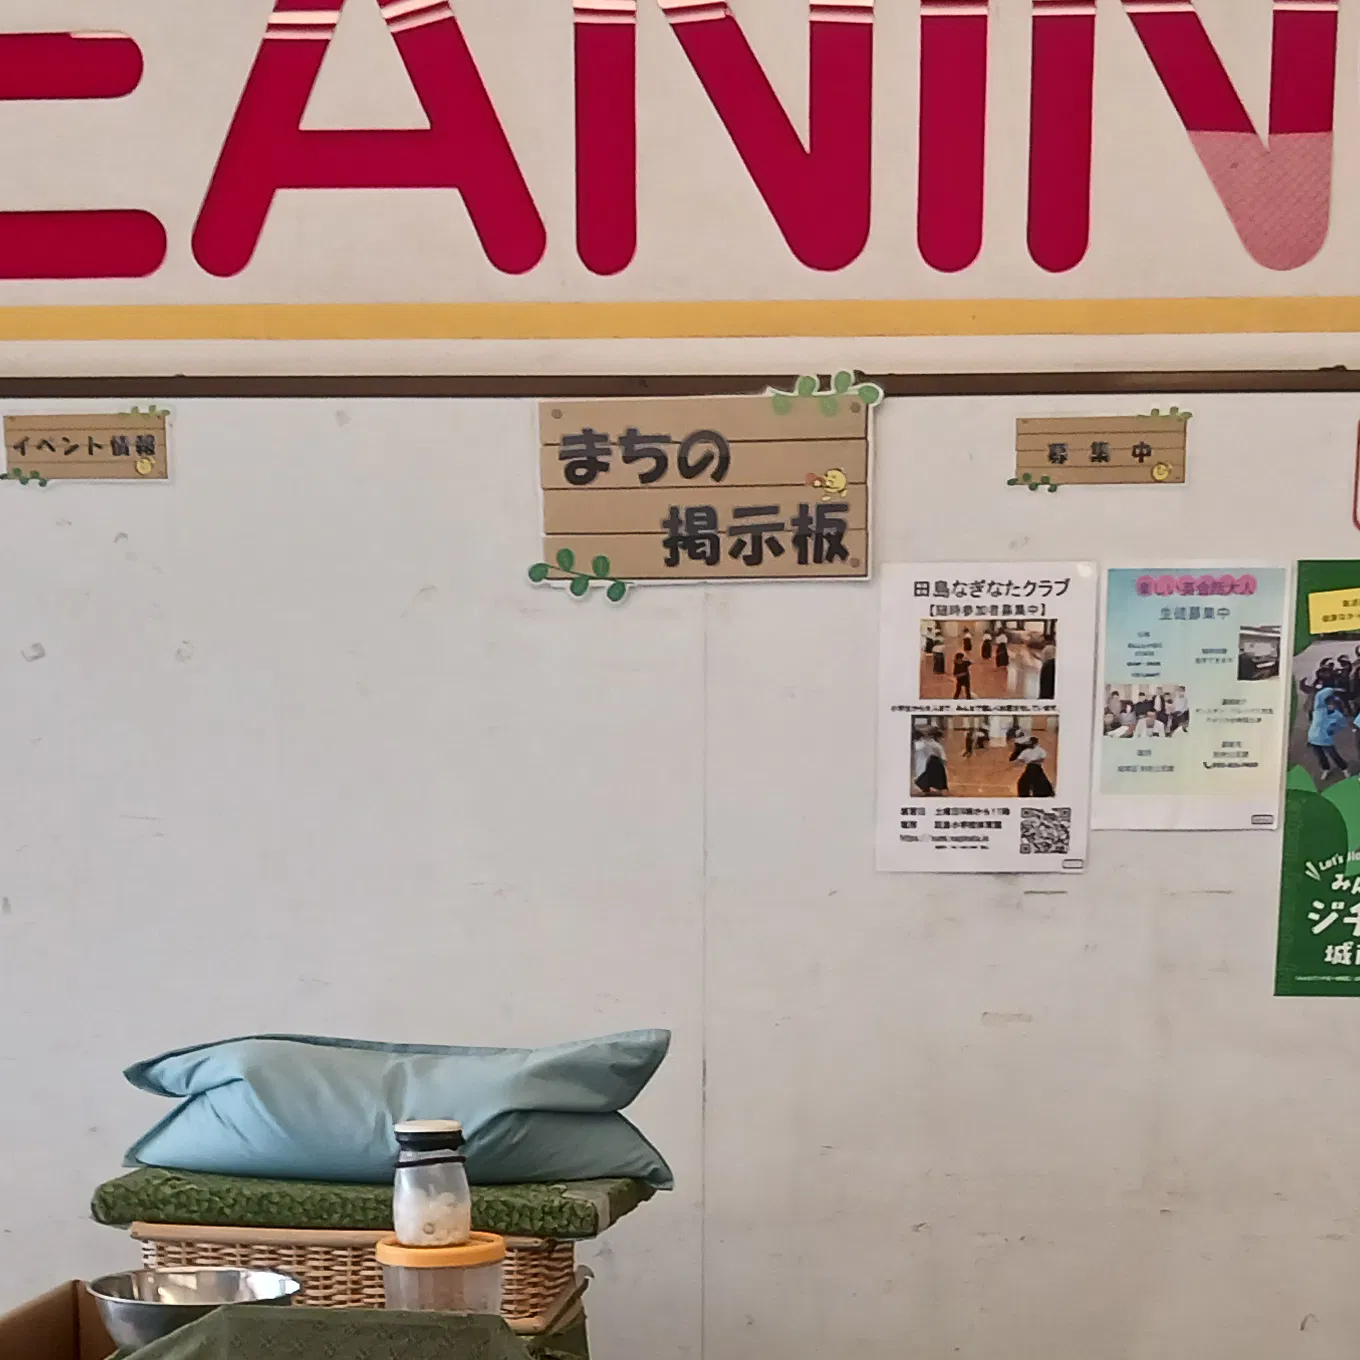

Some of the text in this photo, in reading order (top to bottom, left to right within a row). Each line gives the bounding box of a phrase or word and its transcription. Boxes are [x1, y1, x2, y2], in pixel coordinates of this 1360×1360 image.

[558, 427, 731, 486] まちの
[661, 502, 851, 568] 掲示板
[913, 577, 1070, 599] 田島なぎなたクラブ
